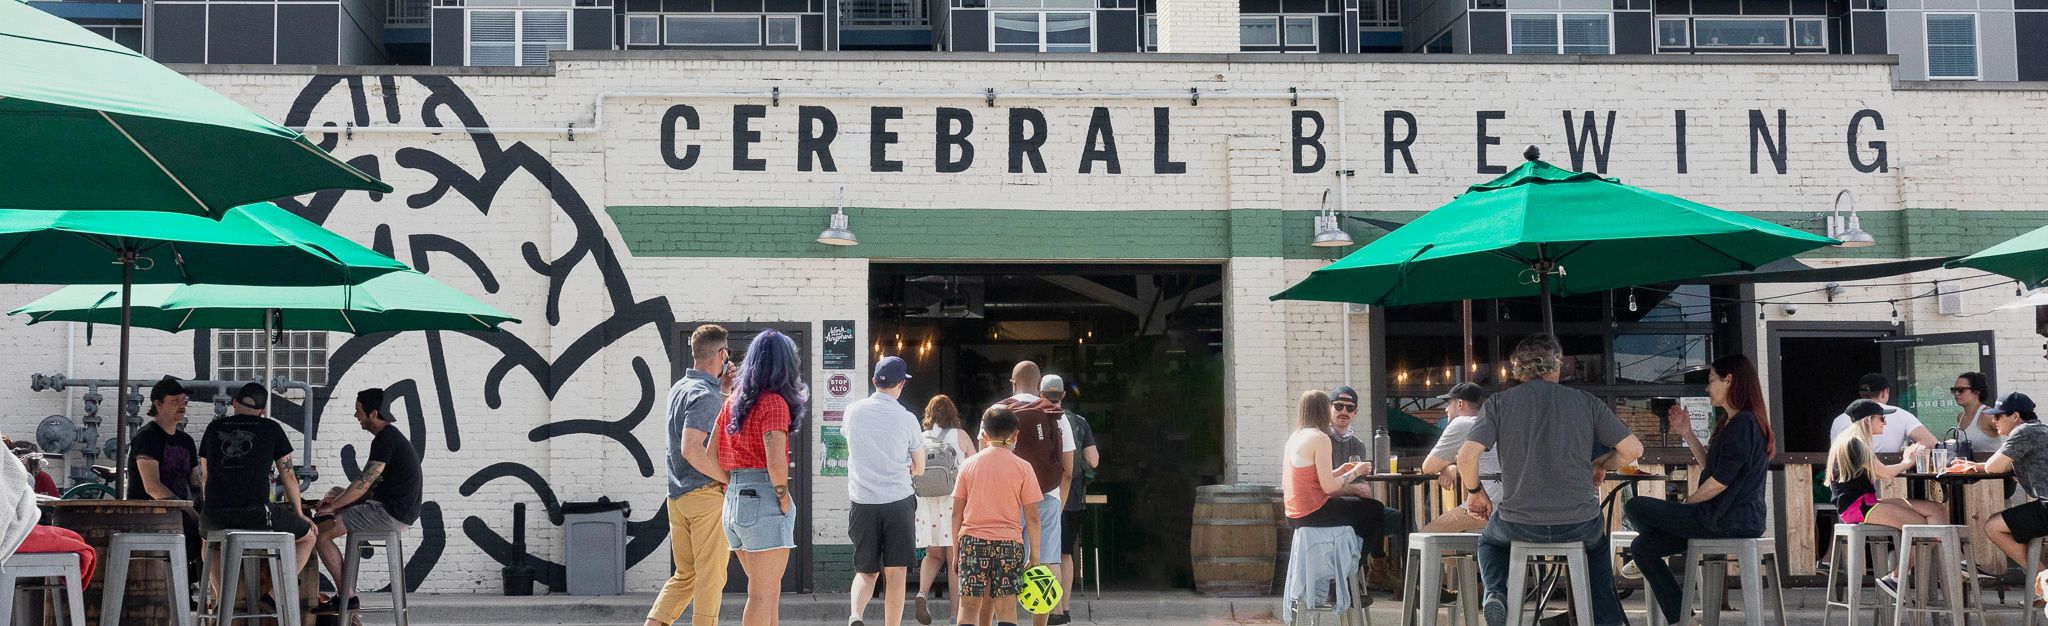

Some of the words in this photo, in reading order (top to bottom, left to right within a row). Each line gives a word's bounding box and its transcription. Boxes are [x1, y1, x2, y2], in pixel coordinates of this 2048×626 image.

[660, 104, 1188, 174] CEREBRAL
[1291, 109, 1889, 175] BREWING
[1036, 423, 1044, 441] THULE
